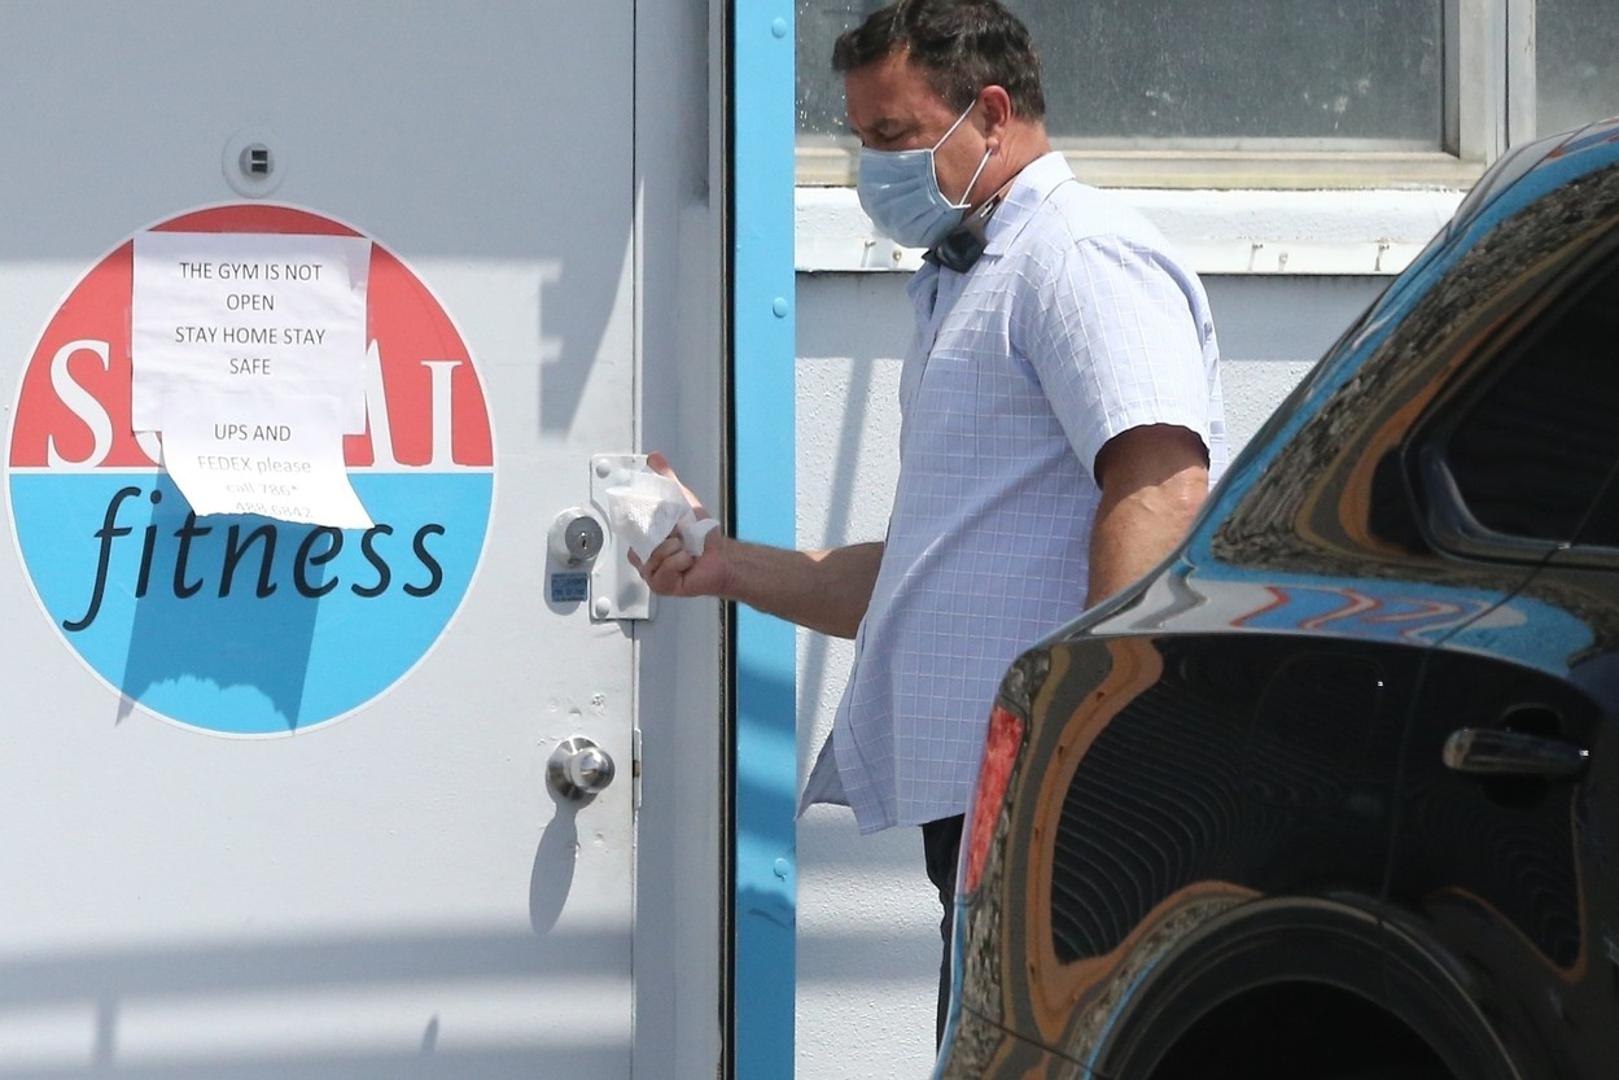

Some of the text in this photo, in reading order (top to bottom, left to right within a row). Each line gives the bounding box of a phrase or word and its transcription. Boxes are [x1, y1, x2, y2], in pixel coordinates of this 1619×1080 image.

[179, 262, 322, 281] THE GYM IS NOT
[226, 293, 274, 311] OPEN
[175, 326, 326, 345] STAY HOME STAY
[229, 358, 271, 375] SAFE
[214, 423, 291, 442] UPS AND
[197, 456, 311, 475] FEDEX please
[62, 486, 446, 632] fitness
